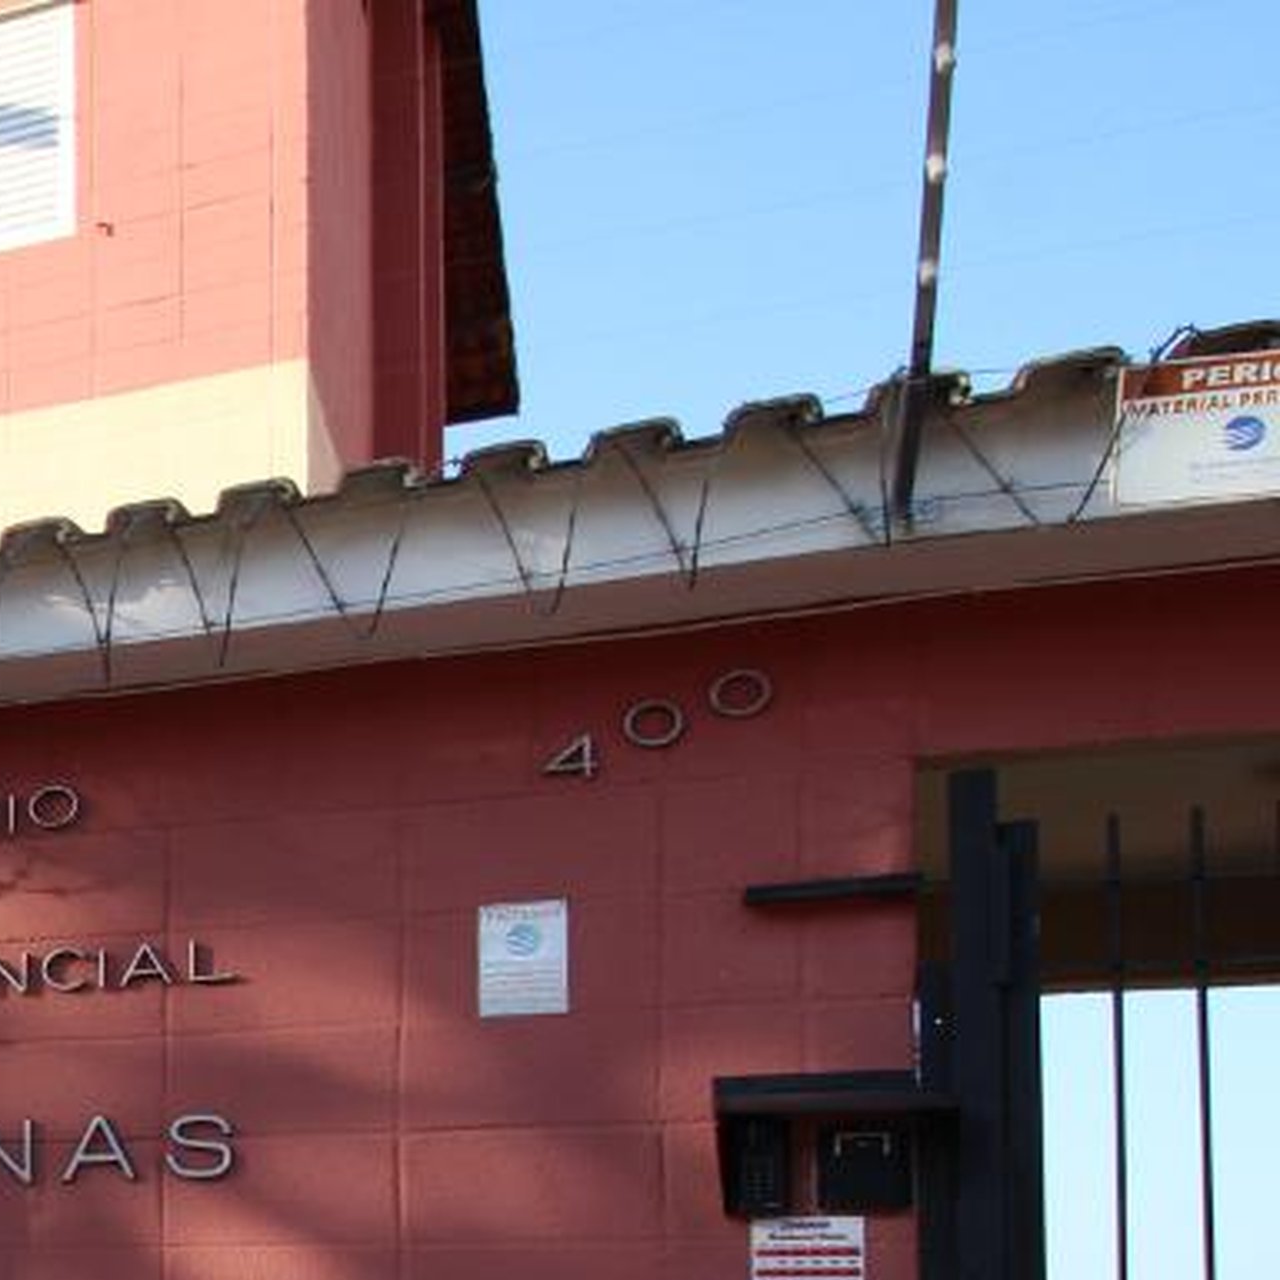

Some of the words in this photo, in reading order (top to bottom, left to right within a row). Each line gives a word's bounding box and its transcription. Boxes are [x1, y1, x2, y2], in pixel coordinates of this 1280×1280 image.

[1181, 361, 1280, 391] PERI
[1123, 393, 1231, 417] MATERIAL
[543, 668, 772, 778] 400
